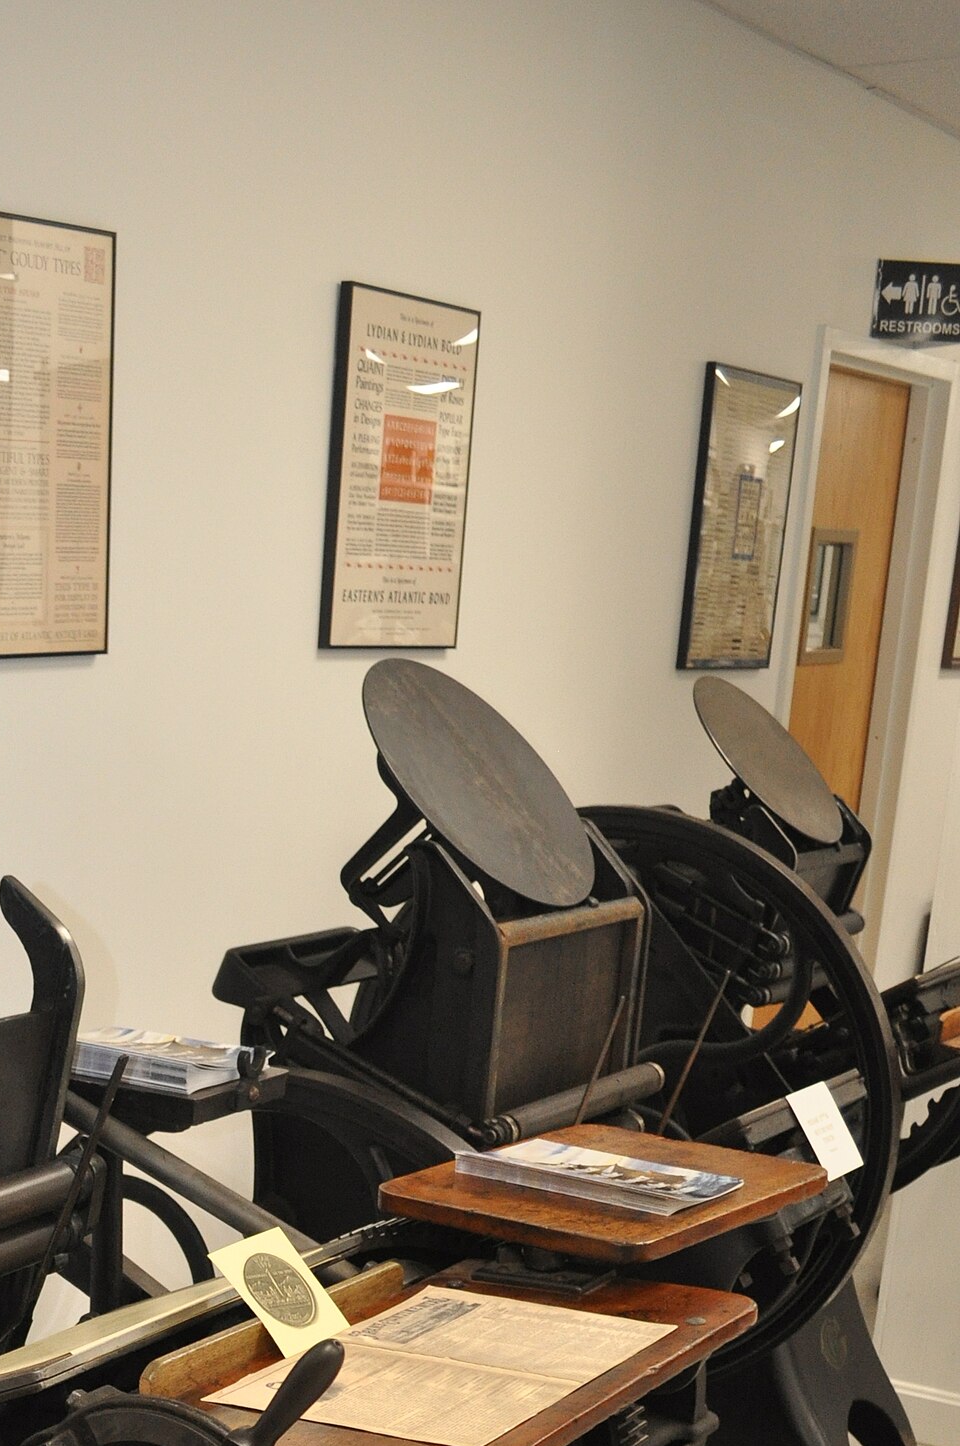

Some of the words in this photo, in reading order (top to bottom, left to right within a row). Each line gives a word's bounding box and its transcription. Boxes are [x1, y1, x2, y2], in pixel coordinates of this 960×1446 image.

[9, 251, 49, 272] GOUDY
[52, 258, 82, 276] TYPES
[880, 320, 960, 335] RESTROOMS
[367, 323, 398, 341] LYDIAN
[408, 332, 439, 350] LYDIAN
[441, 339, 463, 356] BOLD
[388, 590, 427, 604] ATLANTIC
